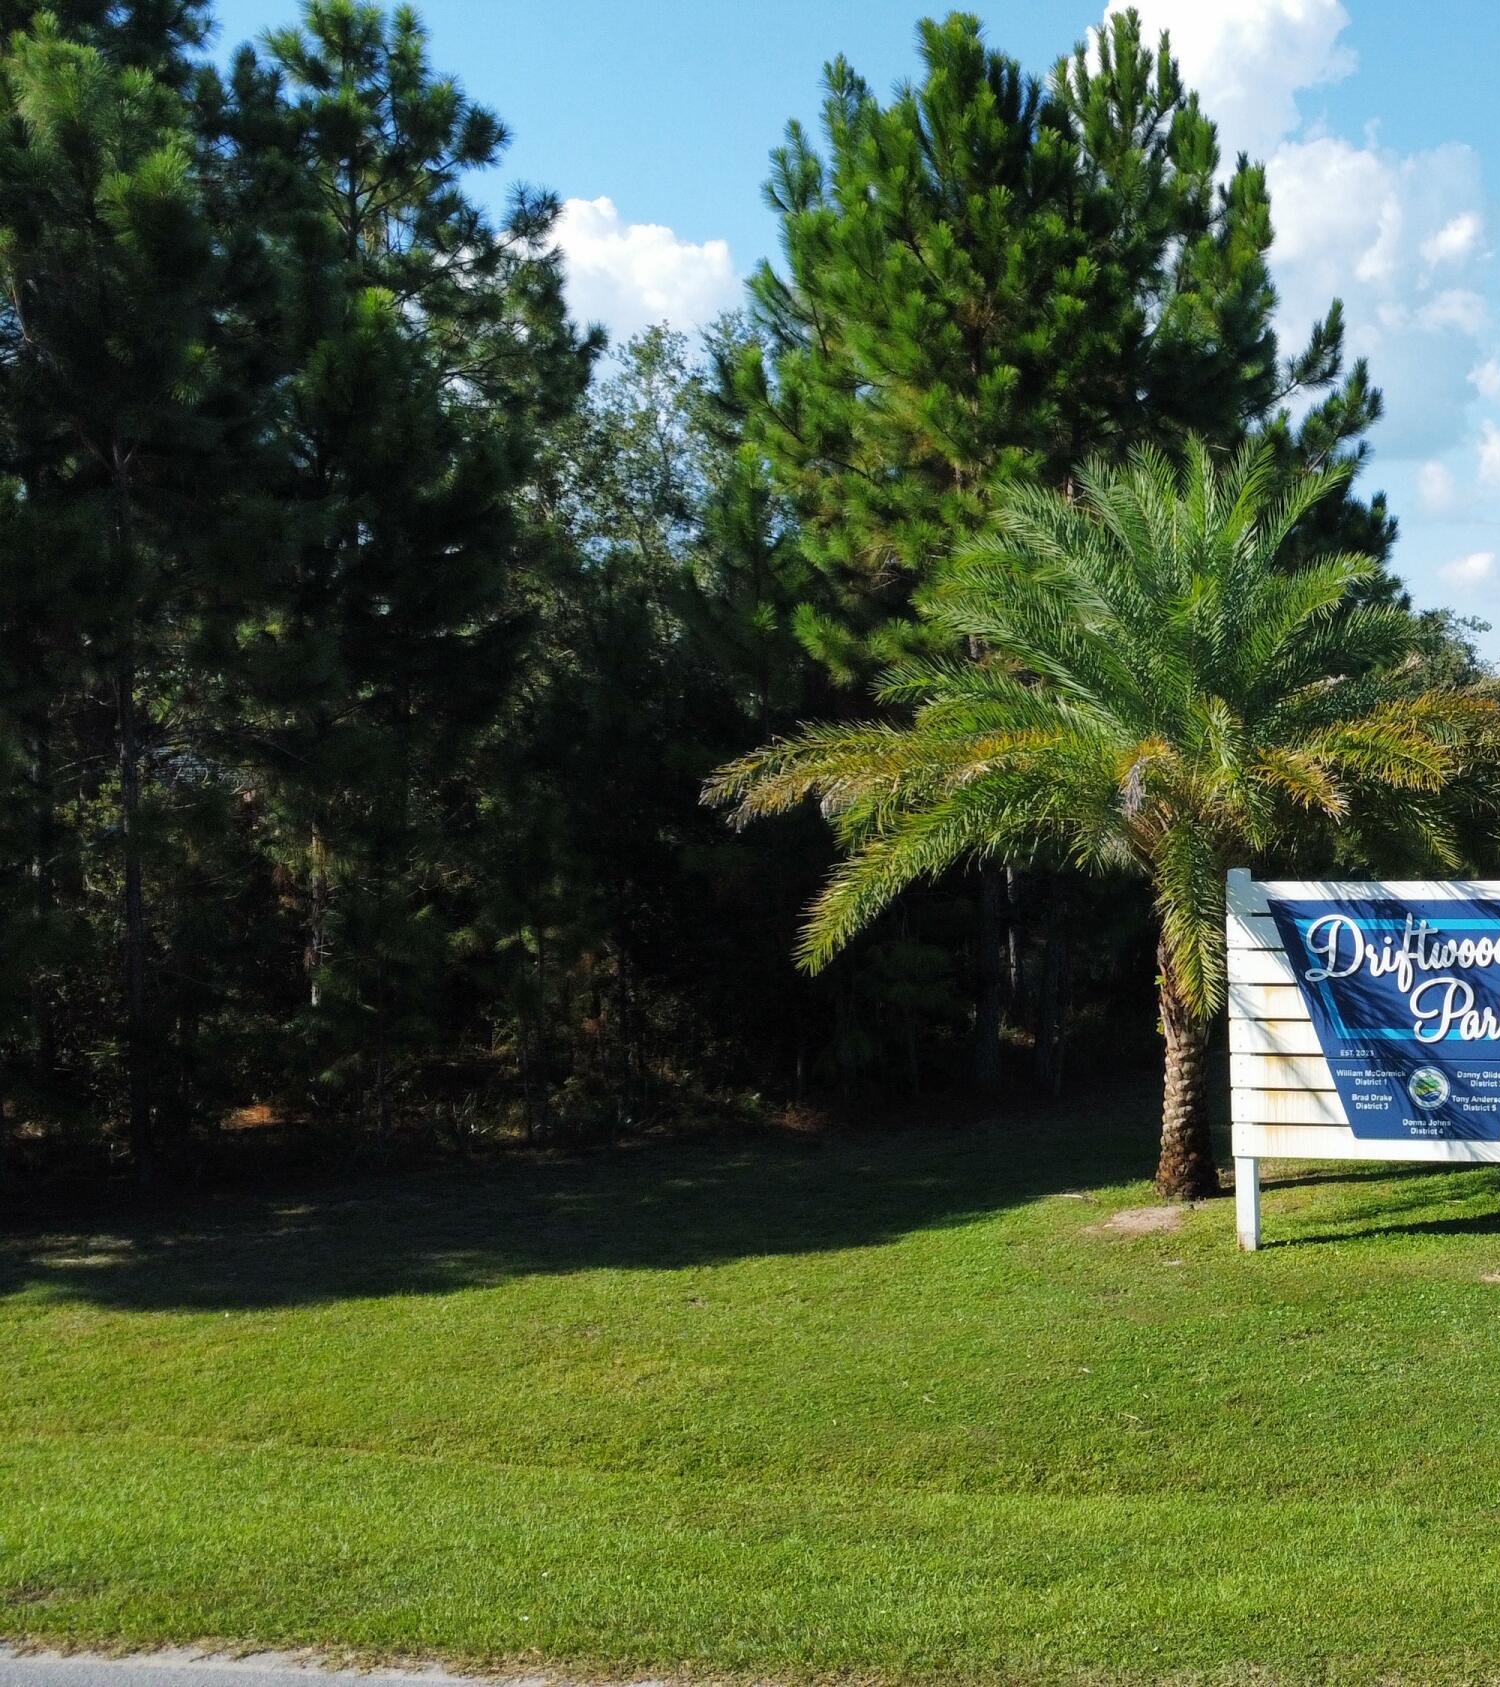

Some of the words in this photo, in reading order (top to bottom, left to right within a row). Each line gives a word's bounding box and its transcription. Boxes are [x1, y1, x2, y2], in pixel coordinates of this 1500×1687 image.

[1336, 1069, 1363, 1077] William
[1456, 1071, 1481, 1079] Danny
[1355, 1078, 1382, 1086] District
[1470, 1079, 1498, 1087] District
[1351, 1093, 1370, 1101] Brad
[1370, 1093, 1393, 1101] Drake
[1451, 1095, 1470, 1103] Tony
[1355, 1102, 1383, 1110] District
[1463, 1103, 1490, 1112] District
[1402, 1118, 1427, 1126] Donna
[1410, 1127, 1438, 1135] District
